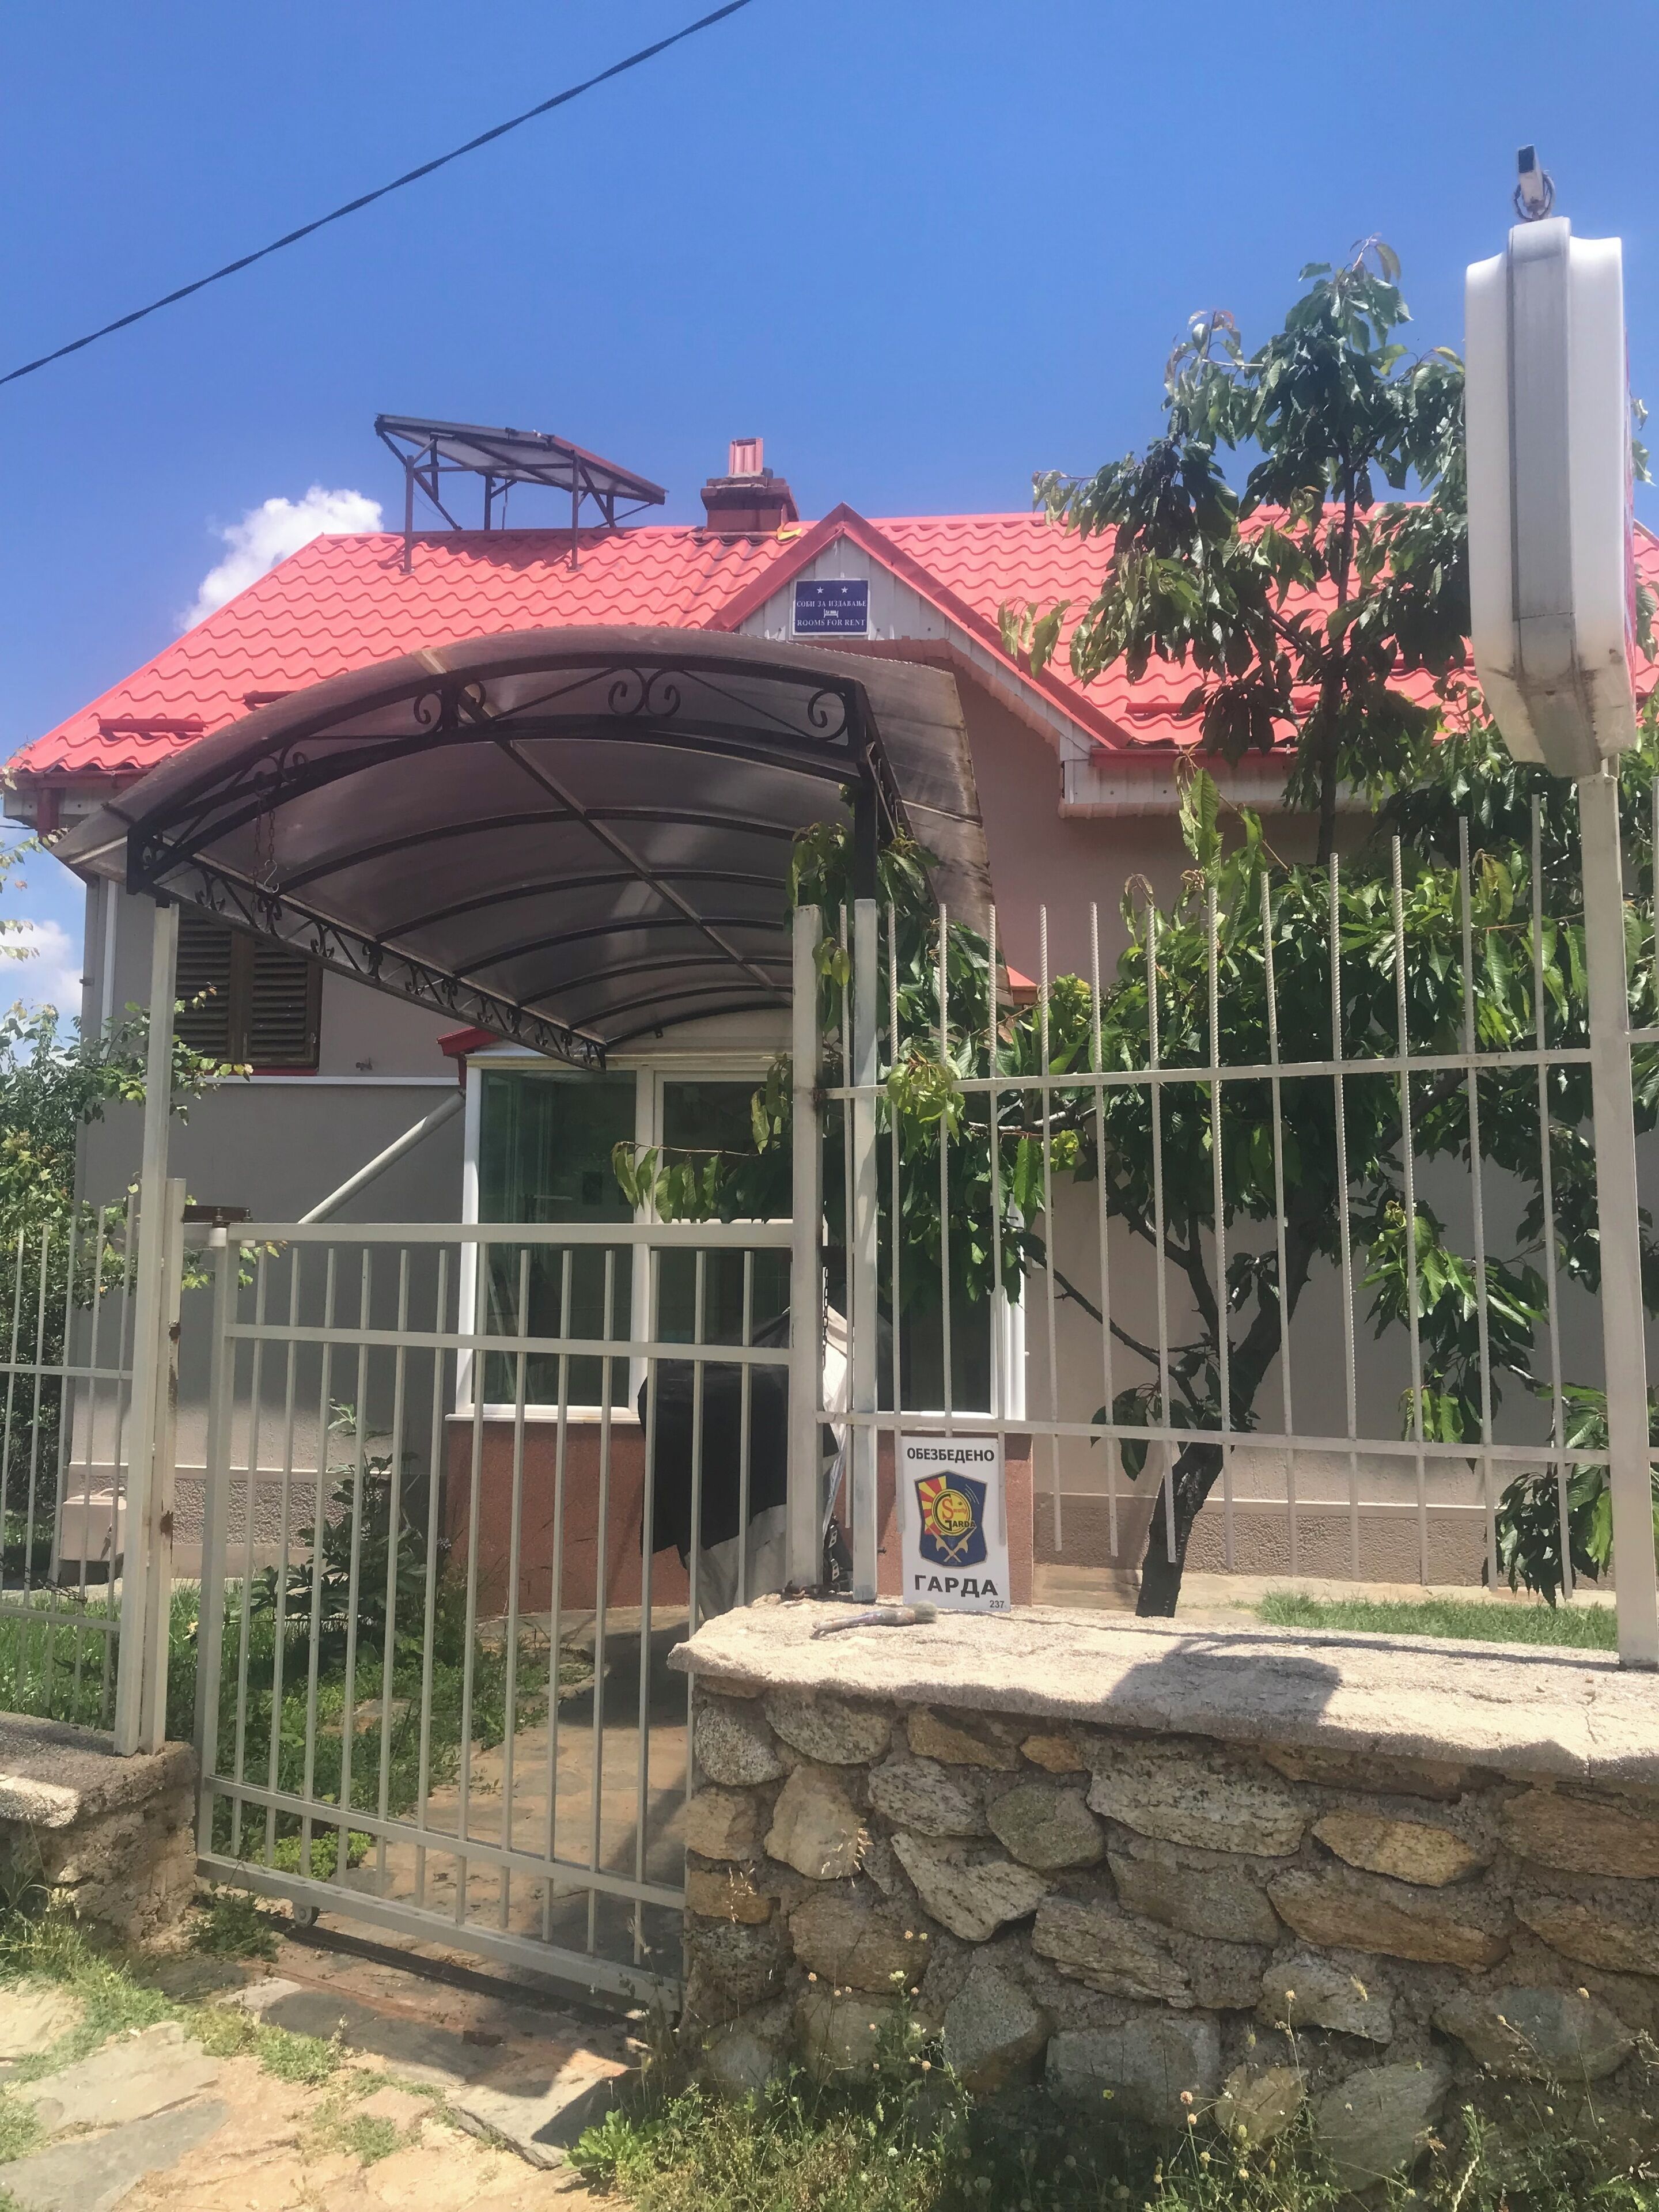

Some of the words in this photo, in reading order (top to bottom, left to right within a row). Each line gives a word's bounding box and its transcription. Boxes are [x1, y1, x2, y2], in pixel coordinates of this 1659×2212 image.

[907, 1447, 995, 1464] ОБЕЗБЕДЕНО
[914, 1574, 998, 1598] ГАРДА
[989, 1600, 1005, 1609] 237
